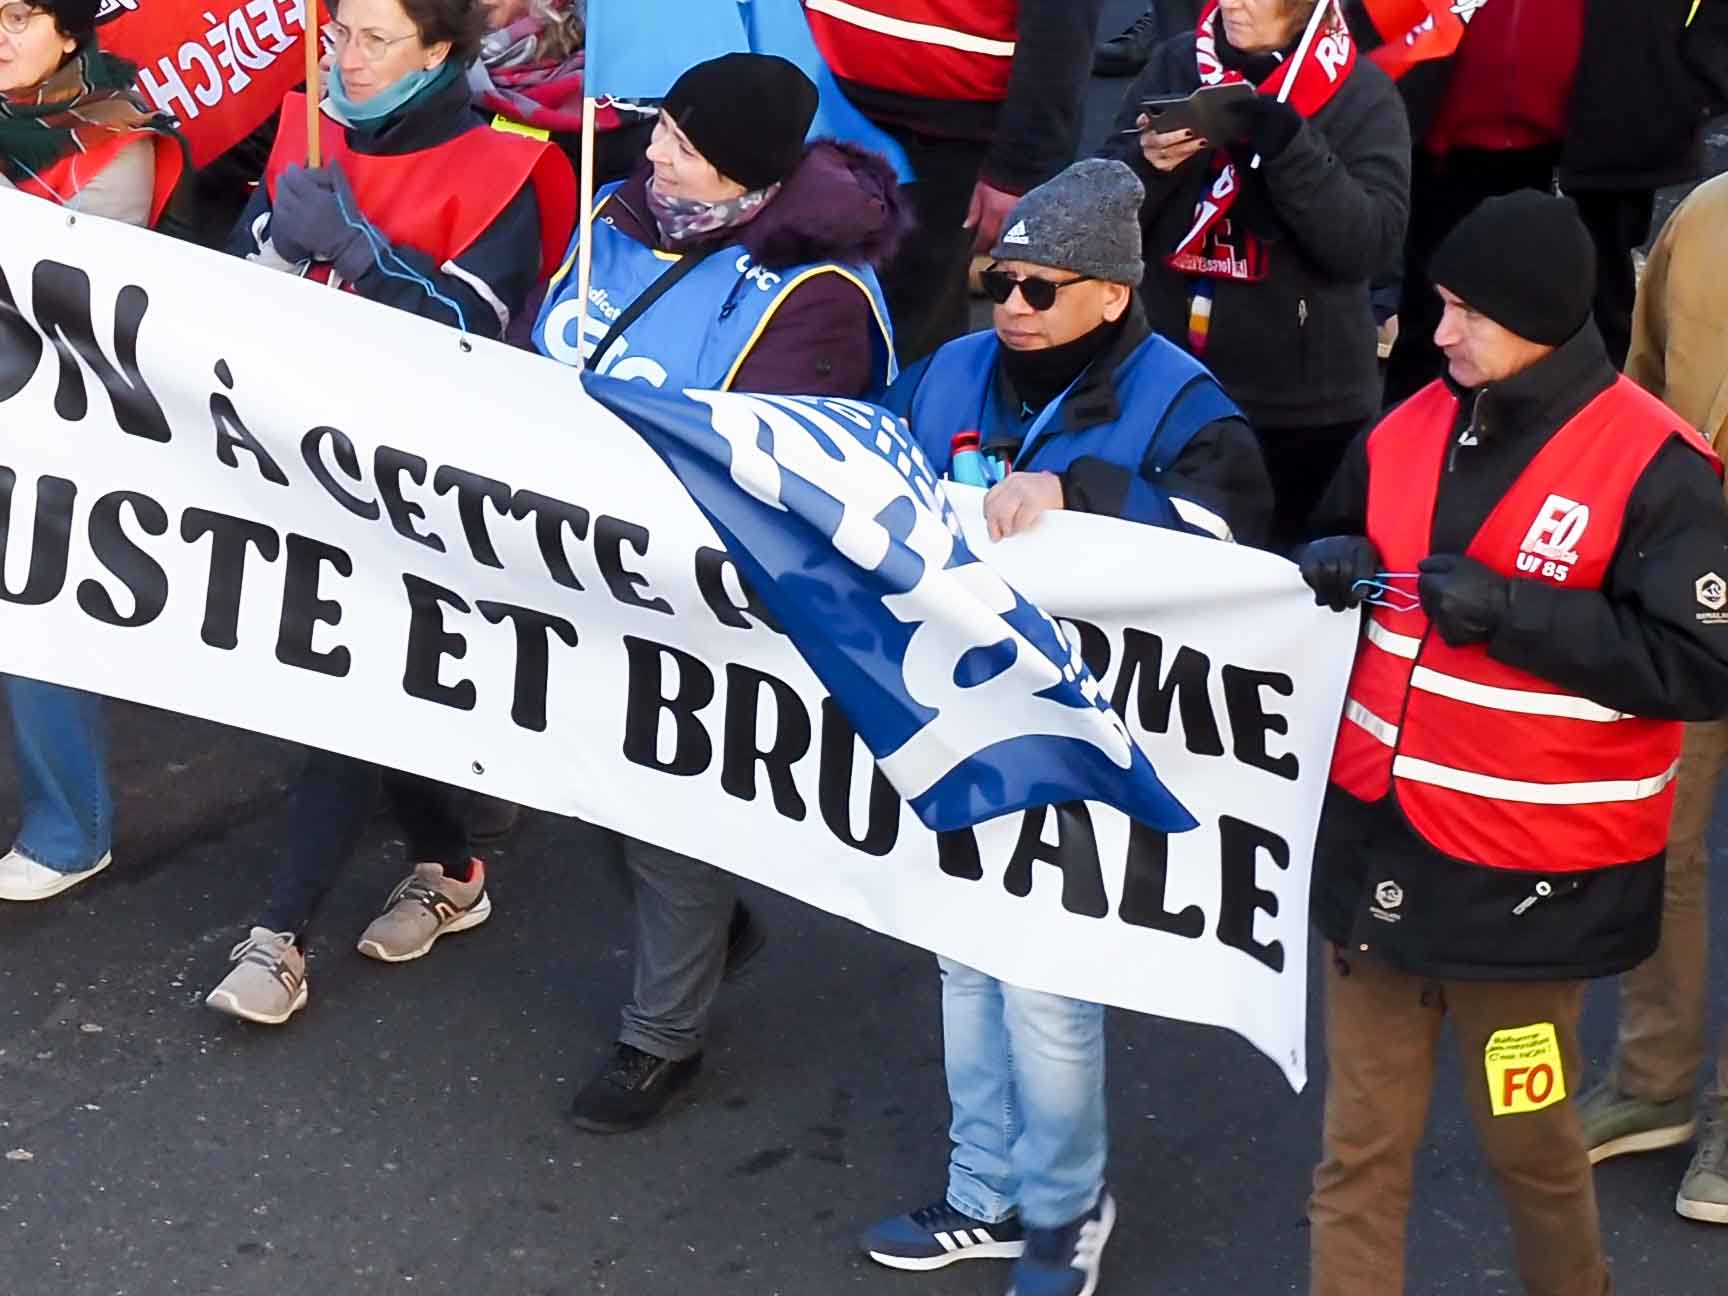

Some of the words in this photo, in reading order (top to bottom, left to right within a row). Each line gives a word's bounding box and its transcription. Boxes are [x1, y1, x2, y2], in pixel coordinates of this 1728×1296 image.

[213, 359, 290, 487] À
[300, 425, 673, 616] CETTE
[1520, 494, 1590, 556] FO
[1542, 562, 1569, 582] 85
[402, 572, 579, 733] ET
[1503, 1063, 1554, 1107] FO
